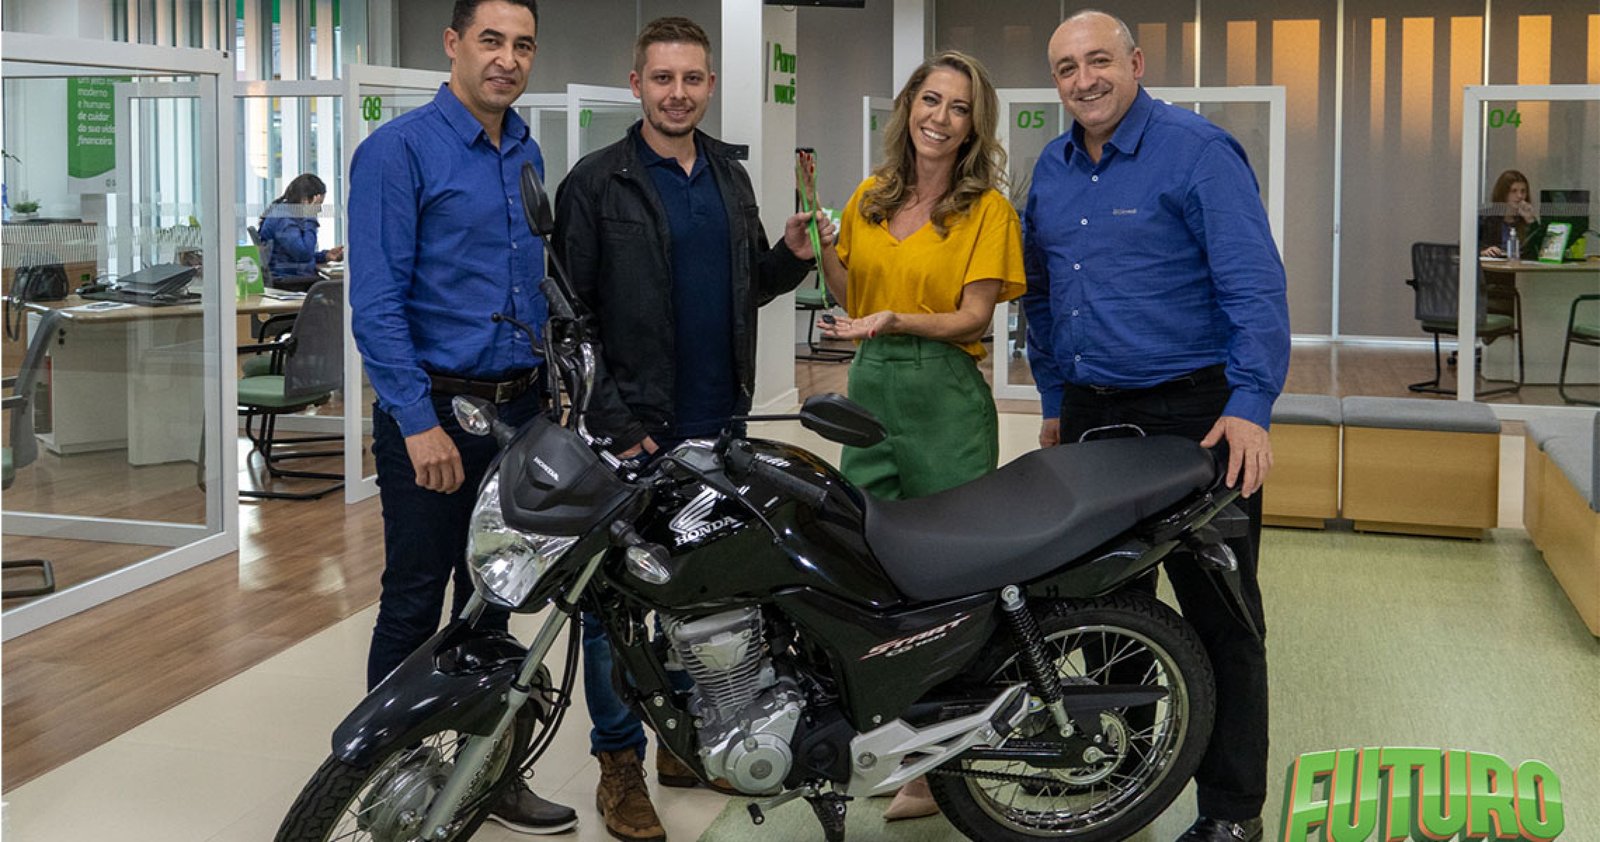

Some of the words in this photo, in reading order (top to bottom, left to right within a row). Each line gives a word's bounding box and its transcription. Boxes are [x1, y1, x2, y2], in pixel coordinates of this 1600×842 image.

[362, 97, 382, 121] 08
[1017, 110, 1045, 129] 05
[1489, 109, 1522, 128] 04
[533, 456, 560, 482] HONDA
[674, 515, 739, 546] HONDA
[860, 613, 971, 660] START
